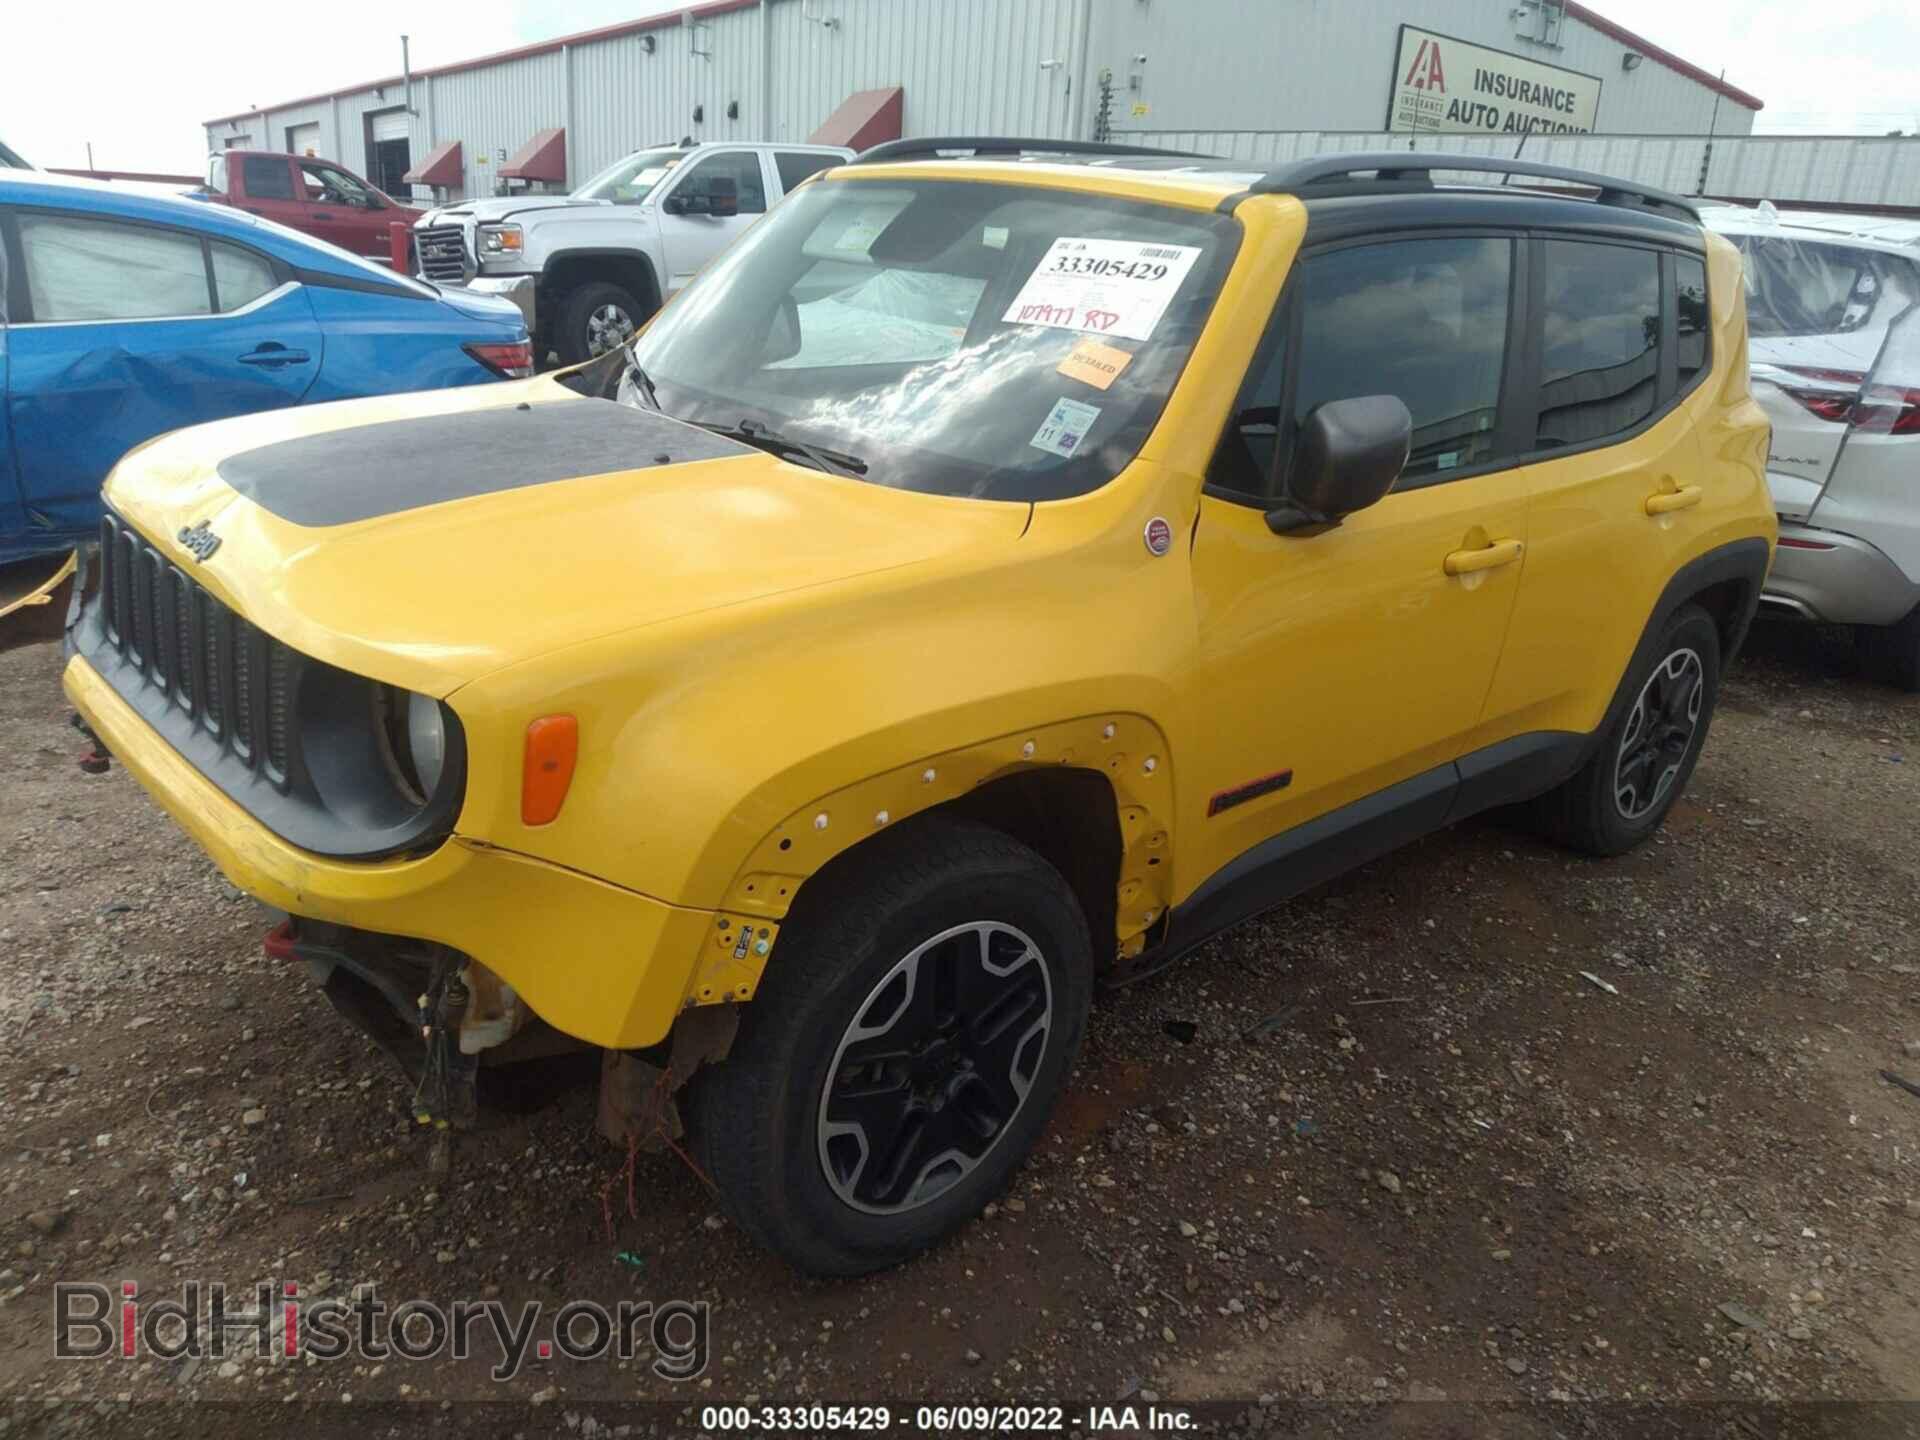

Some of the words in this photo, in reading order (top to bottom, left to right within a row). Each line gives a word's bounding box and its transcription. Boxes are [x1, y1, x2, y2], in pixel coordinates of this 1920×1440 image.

[1474, 68, 1576, 113] INSURANCE
[1446, 98, 1499, 129] AUTO
[1503, 111, 1588, 135] AUCTIO
[1050, 256, 1169, 281] 33305429
[1083, 309, 1121, 330] RD
[1040, 427, 1055, 441] 11
[177, 520, 222, 564] Jeep
